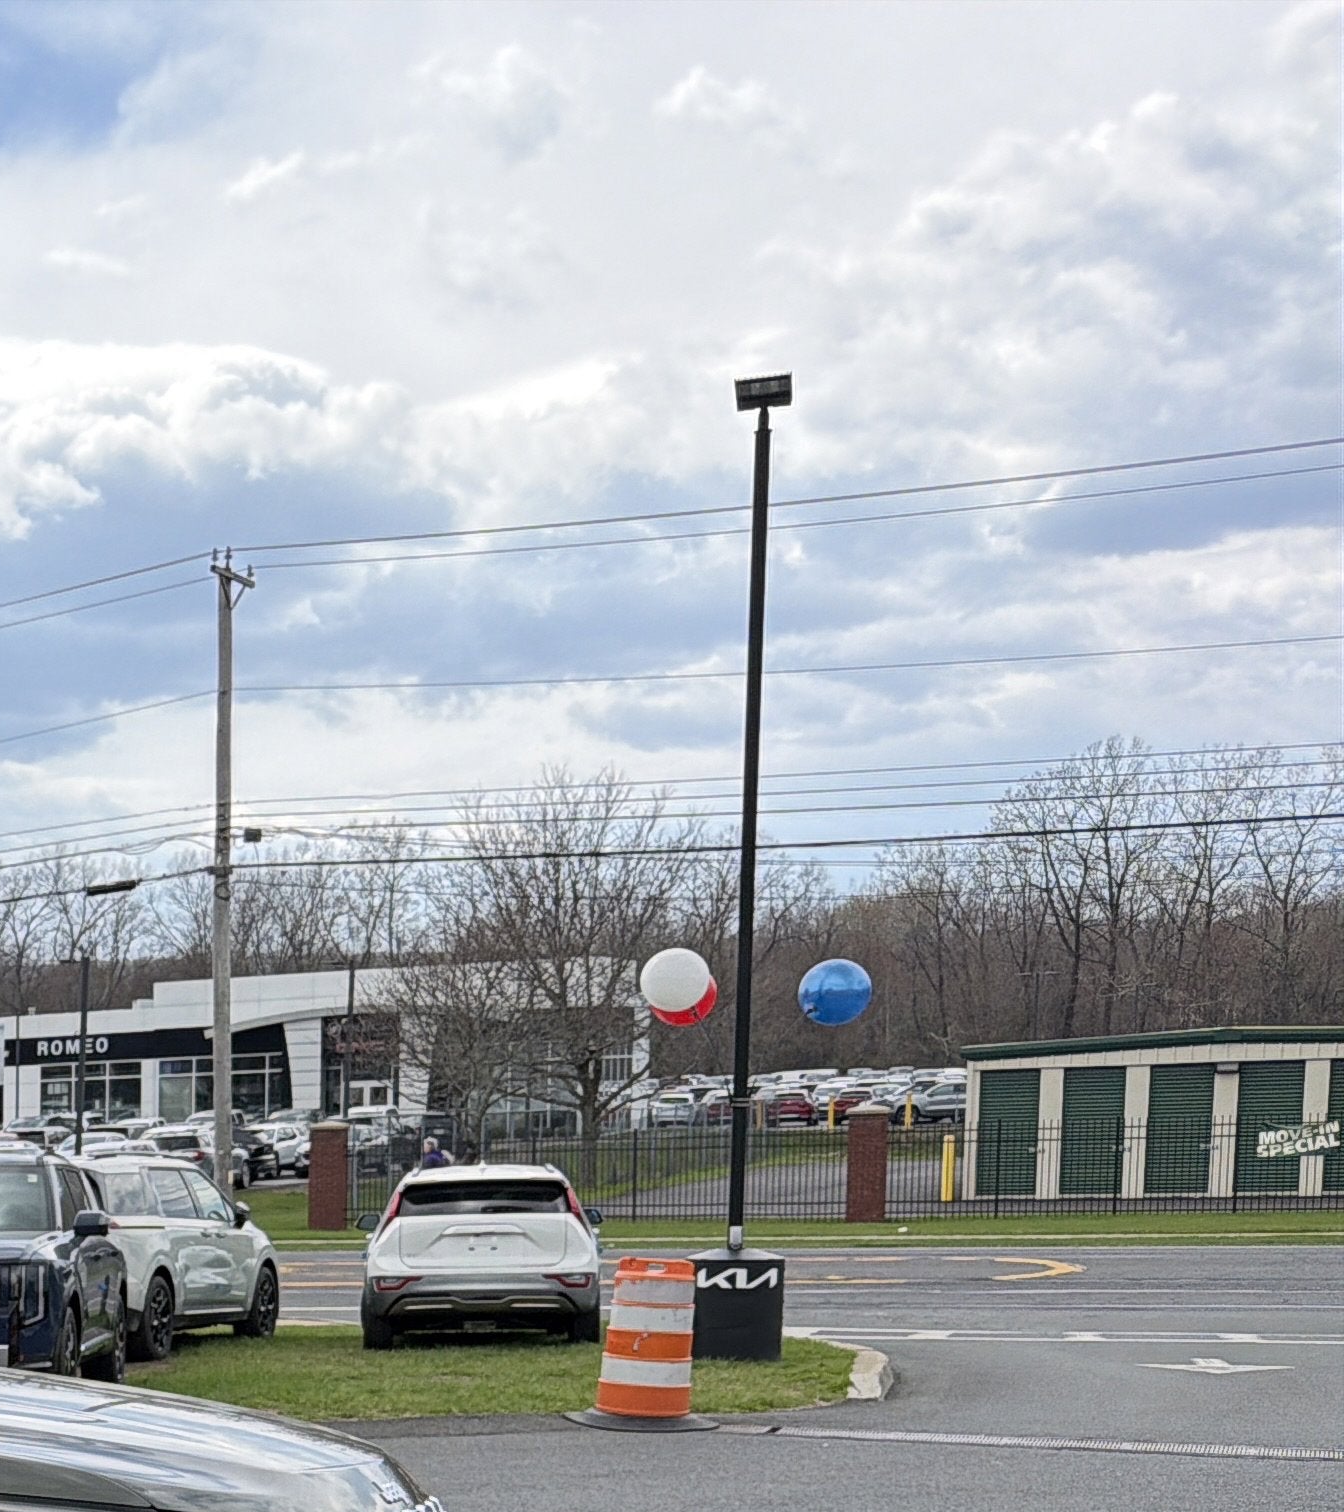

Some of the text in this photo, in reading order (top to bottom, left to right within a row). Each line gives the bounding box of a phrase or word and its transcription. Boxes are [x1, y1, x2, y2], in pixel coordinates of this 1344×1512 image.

[36, 1037, 109, 1057] ROMEO
[1258, 1120, 1340, 1145] MOVE-IN
[1256, 1133, 1341, 1157] SPECIAL
[696, 1267, 779, 1289] KIA
